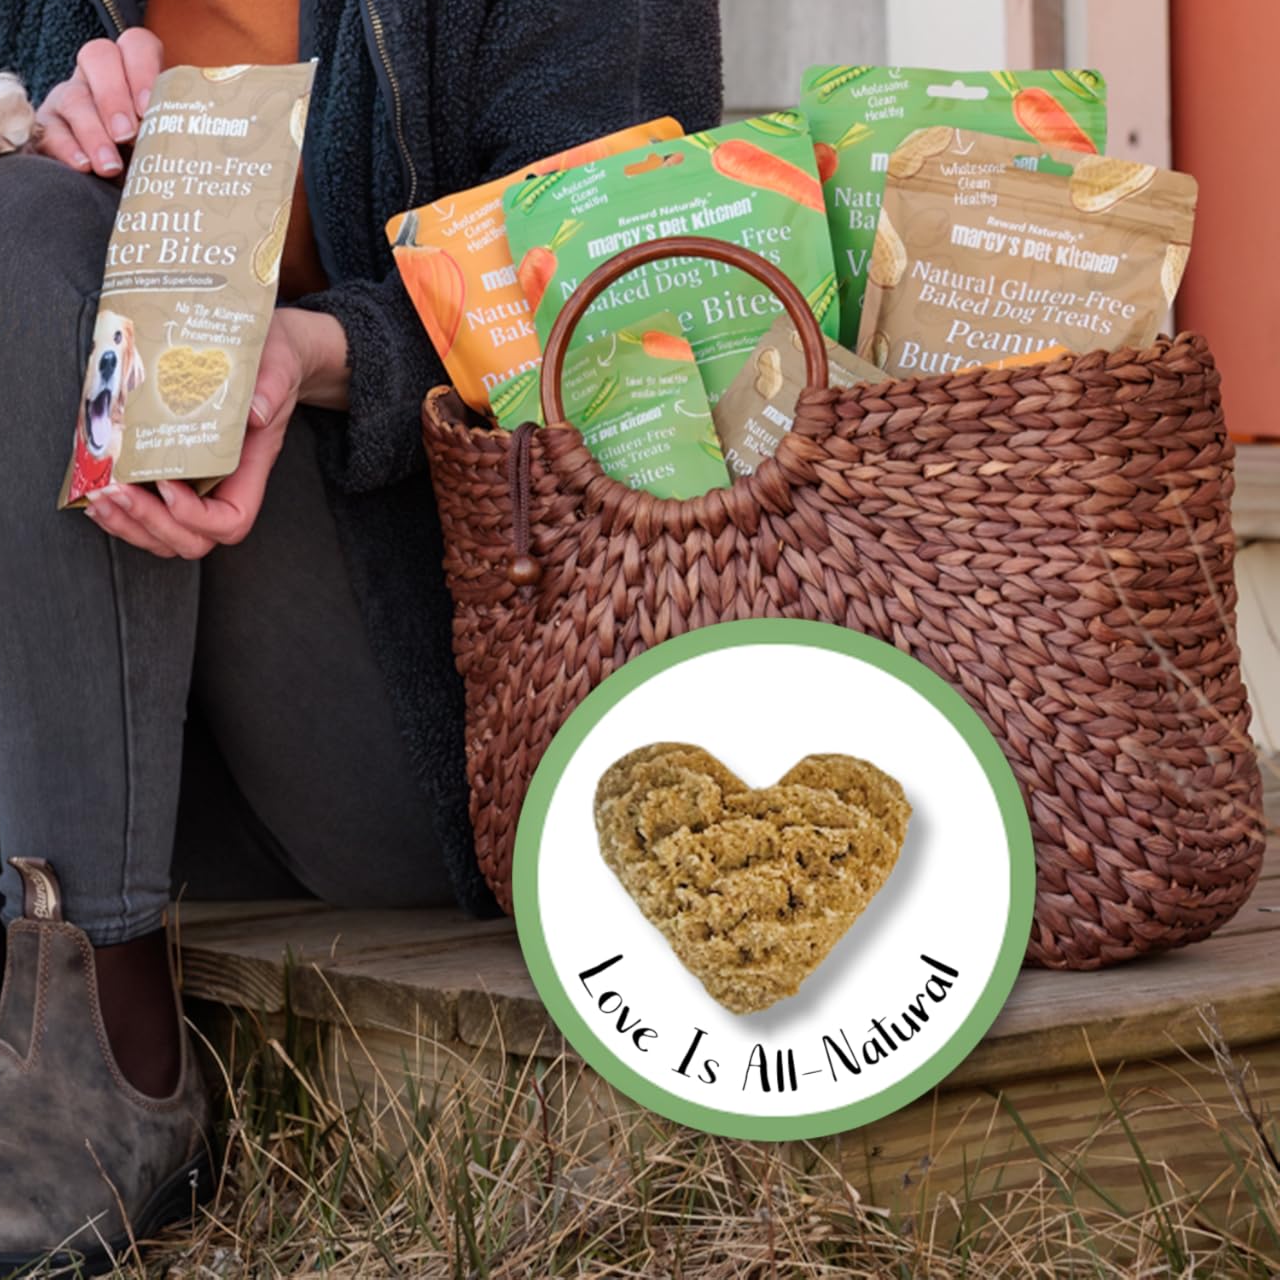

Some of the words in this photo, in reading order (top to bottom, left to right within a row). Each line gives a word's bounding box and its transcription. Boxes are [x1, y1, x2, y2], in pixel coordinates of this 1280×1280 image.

[140, 154, 272, 177] Gluten-Free
[134, 176, 175, 200] Dog
[181, 175, 253, 197] Treats
[958, 177, 991, 191] Clean
[116, 208, 204, 233] eanut
[106, 242, 151, 266] ter
[158, 236, 238, 266] Bites
[655, 266, 704, 296] Dog
[910, 260, 996, 297] Natural
[1000, 278, 1137, 321] Gluten-Free
[700, 290, 785, 326] Bites
[918, 284, 990, 317] Baked
[992, 299, 1037, 326] Dog
[1042, 304, 1114, 336] Treats
